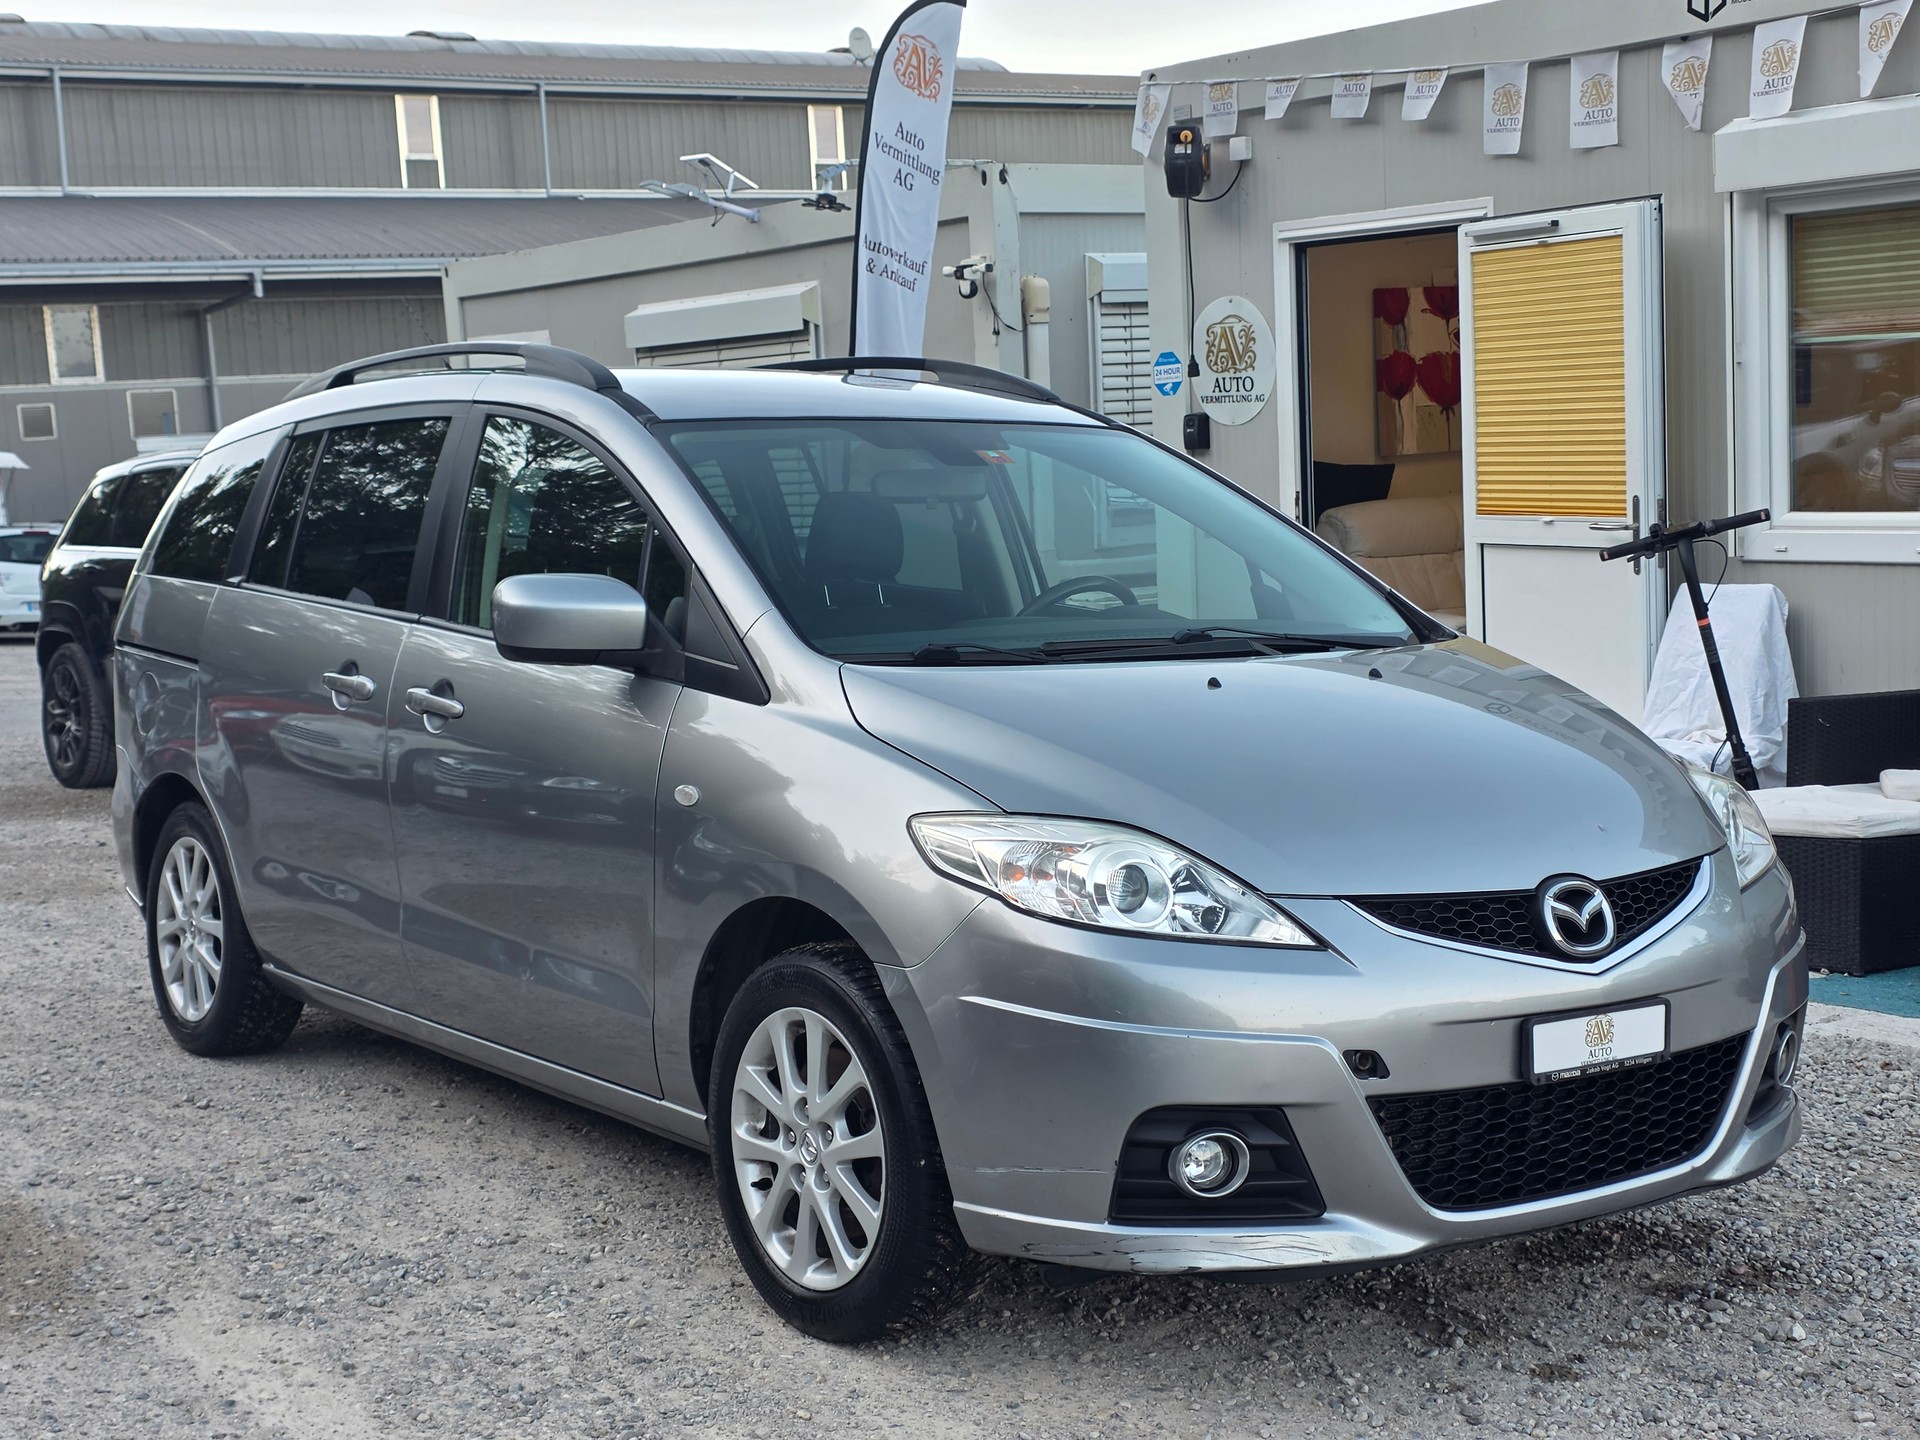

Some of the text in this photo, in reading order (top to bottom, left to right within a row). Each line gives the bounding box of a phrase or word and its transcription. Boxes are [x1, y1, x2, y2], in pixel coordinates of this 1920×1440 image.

[1343, 82, 1366, 93] AUTO
[1763, 75, 1793, 89] AUTO
[1273, 84, 1296, 95] AUTO
[1415, 84, 1438, 95] AUTO
[1211, 101, 1233, 113] AUTO
[1584, 107, 1613, 121] AUTO
[1494, 117, 1520, 128] AUTO
[895, 120, 925, 151] Auto
[875, 131, 941, 186] Vermittlung
[893, 167, 915, 191] AG
[863, 232, 928, 276] Autoverkauf
[865, 257, 918, 292] & Ankauf
[1155, 366, 1181, 377] 24 HOUR
[1212, 376, 1255, 394] AUTO
[1200, 393, 1265, 404] VERMITTLUNG AG
[1588, 1046, 1613, 1060] AUTO
[1586, 1065, 1601, 1074] Jakob
[1601, 1063, 1612, 1072] Vogt
